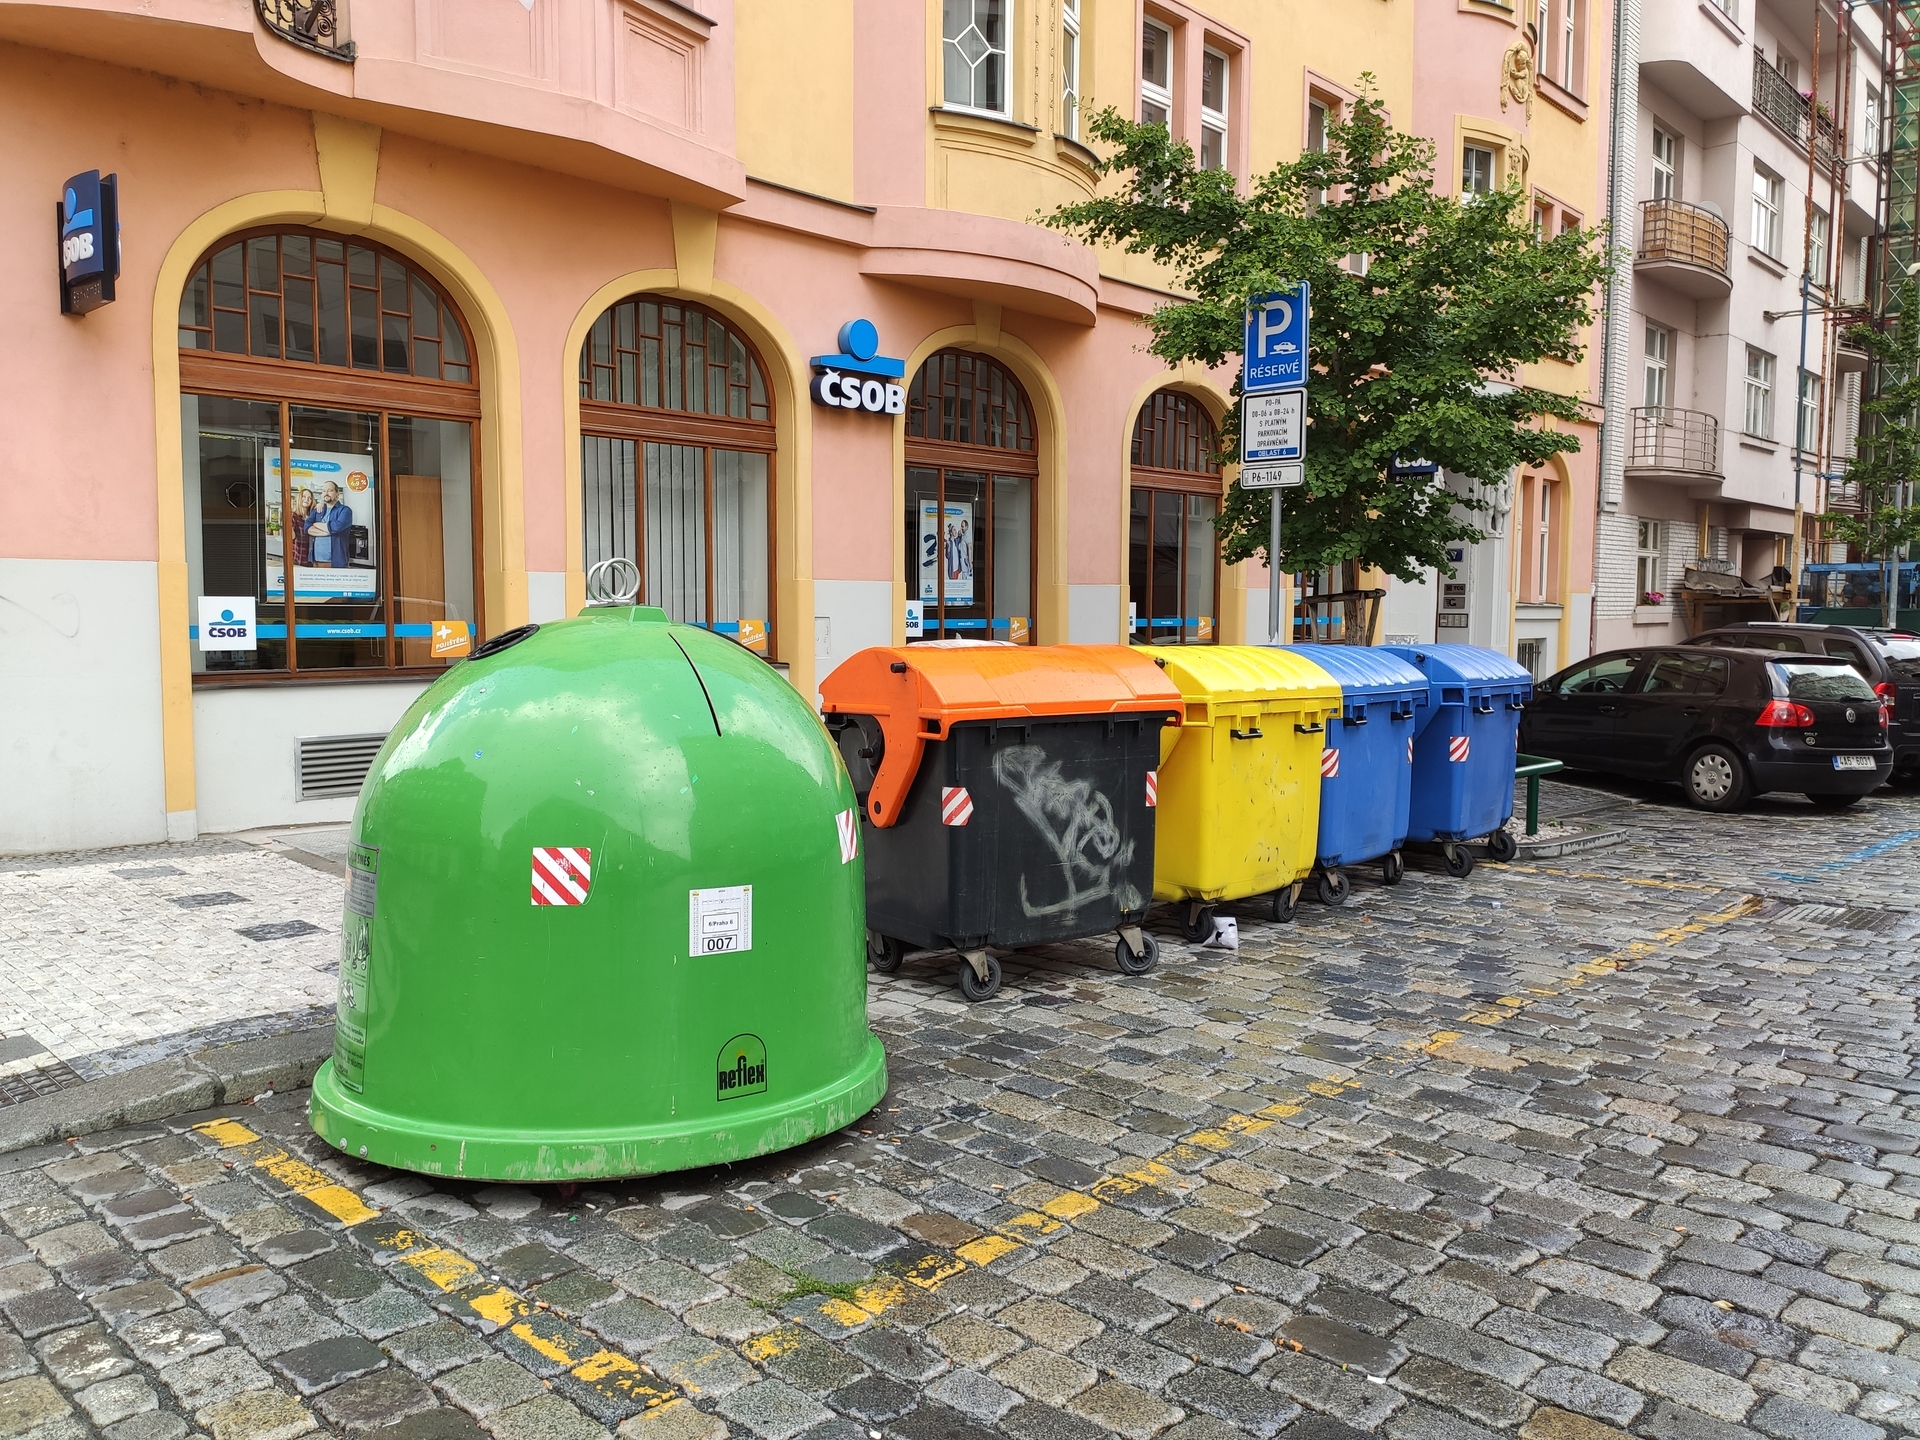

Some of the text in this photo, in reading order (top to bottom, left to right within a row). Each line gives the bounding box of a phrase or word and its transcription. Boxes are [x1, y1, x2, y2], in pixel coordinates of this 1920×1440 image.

[1250, 359, 1299, 379] RÉSERVÉ
[818, 368, 906, 415] ČSOB
[1265, 397, 1281, 406] PO-PÁ
[1265, 417, 1287, 427] PLATNÝM
[1258, 427, 1288, 438] PARKOVACÍM
[1257, 437, 1288, 447] OPRÁVNĚNÍM
[1252, 470, 1282, 482] P6-1149
[906, 621, 920, 629] SOB
[209, 626, 248, 638] ČSOB
[327, 627, 361, 635] www.csob.cz
[707, 937, 733, 951] 007
[719, 1054, 765, 1091] Reflex
